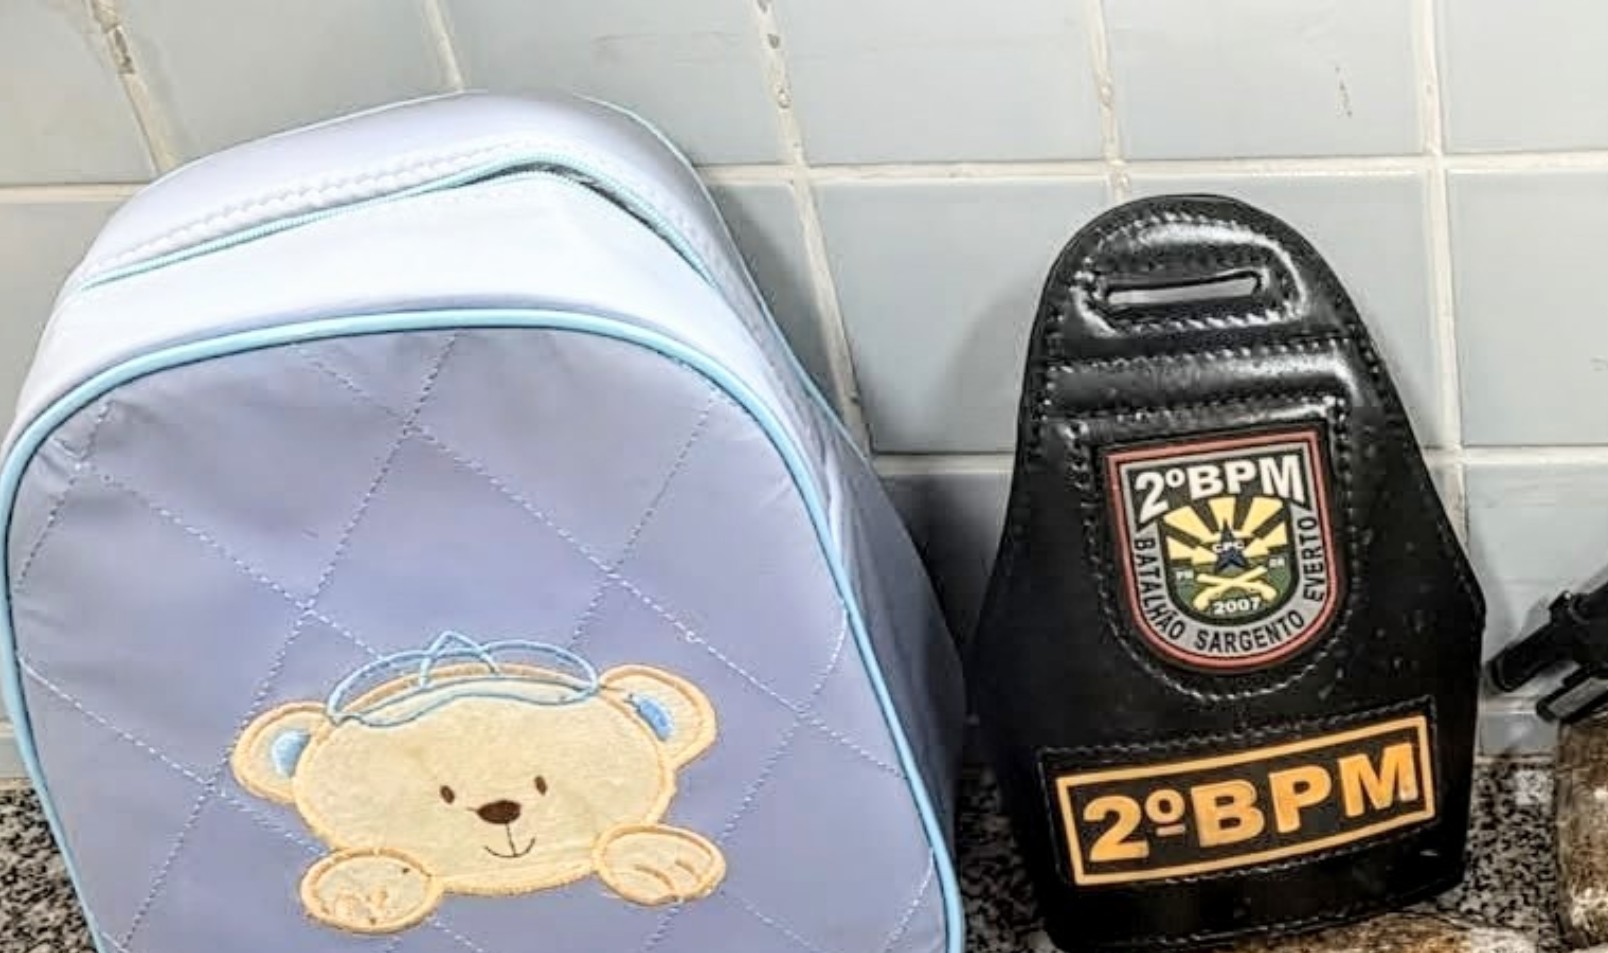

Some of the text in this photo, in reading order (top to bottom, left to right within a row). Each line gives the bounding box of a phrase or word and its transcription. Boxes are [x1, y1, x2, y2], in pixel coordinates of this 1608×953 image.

[1133, 516, 1325, 653] BATALHÃO SARGENTO EVERTO
[1212, 596, 1261, 616] 2007
